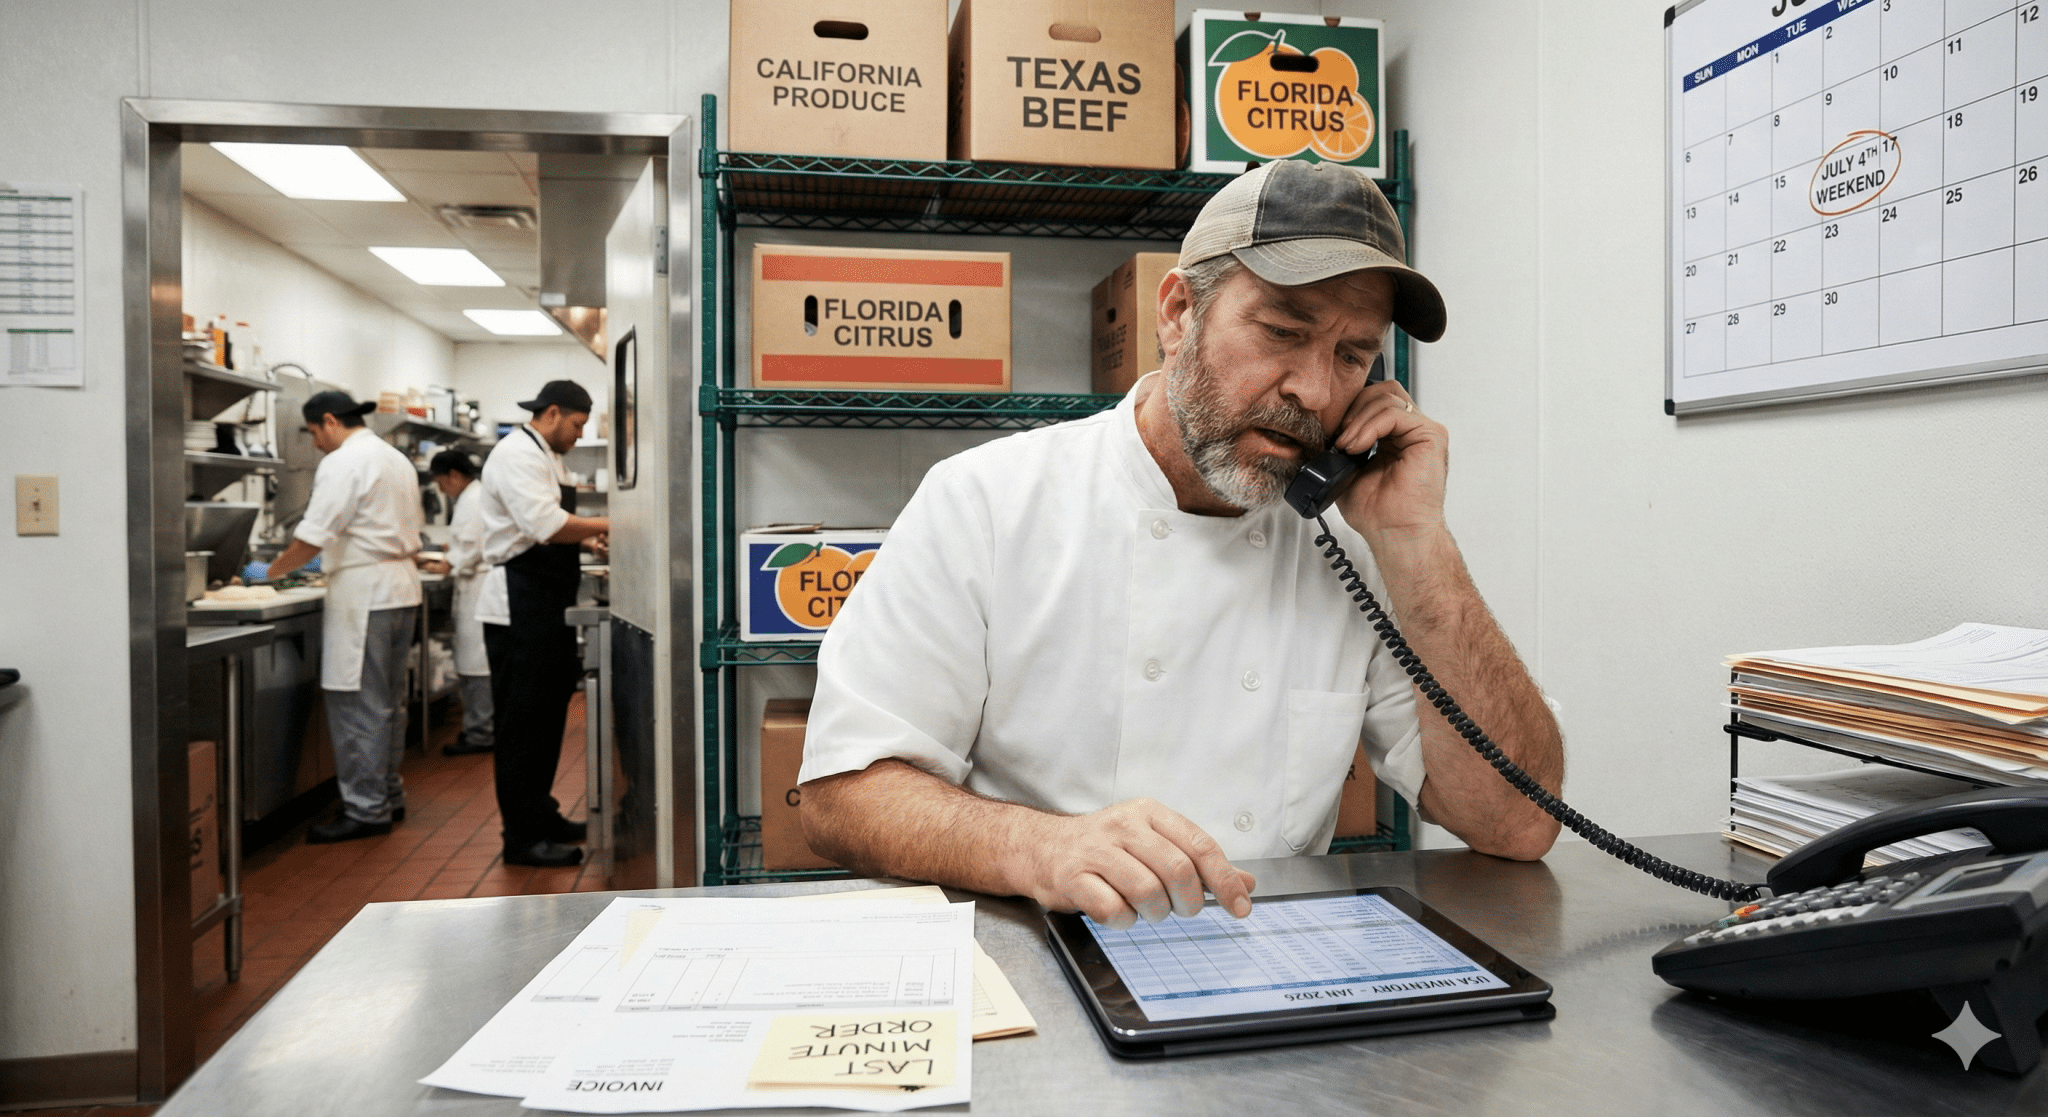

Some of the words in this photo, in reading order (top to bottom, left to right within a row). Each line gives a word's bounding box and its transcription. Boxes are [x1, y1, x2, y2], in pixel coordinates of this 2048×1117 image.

[1775, 52, 1779, 63] 1
[1825, 26, 1833, 39] 2
[1884, 0, 1891, 12] 3
[1694, 66, 1713, 83] SUN
[1737, 44, 1759, 63] MON
[1786, 19, 1807, 37] TUE
[757, 57, 922, 89] CALIFORNIA
[1007, 55, 1141, 96] TEXAS
[1685, 151, 1691, 164] 6
[1728, 134, 1733, 146] 7
[1774, 115, 1780, 128] 8
[1825, 93, 1833, 106] 9
[1884, 66, 1898, 81] 10
[1947, 38, 1962, 54] 11
[2019, 7, 2040, 24] 12
[773, 85, 906, 114] PRODUCE
[1238, 80, 1354, 106] FLORIDA
[1022, 95, 1128, 132] BEEF
[1247, 108, 1344, 132] CITRUS
[1686, 207, 1697, 220] 13
[1728, 192, 1739, 205] 14
[1774, 175, 1786, 189] 15
[1883, 136, 1897, 152] 17
[1947, 113, 1963, 128] 18
[2019, 86, 2038, 103] 19
[1822, 155, 1854, 180] JULY
[1817, 169, 1885, 205] WEEKEND
[1686, 265, 1696, 277] 20
[1728, 254, 1739, 266] 21
[1774, 240, 1786, 253] 22
[1825, 224, 1839, 239] 23
[1882, 207, 1897, 222] 24
[1946, 188, 1962, 204] 25
[2018, 166, 2038, 184] 26
[824, 298, 944, 323] FLORIDA
[1686, 322, 1696, 335] 27
[1728, 313, 1740, 326] 28
[1774, 303, 1786, 316] 29
[1825, 292, 1838, 306] 30
[833, 324, 934, 348] CITRUS
[800, 571, 864, 591] FLO
[808, 597, 847, 618] CIT
[1325, 987, 1354, 999] JAN
[1372, 978, 1456, 995] INVENTORY
[1457, 975, 1489, 987] USA
[1284, 990, 1323, 1002] 2026
[810, 1021, 932, 1038] ORDER
[789, 1039, 931, 1060] MINUTE
[835, 1059, 934, 1076] LAST
[565, 1080, 663, 1092] INVOICE
